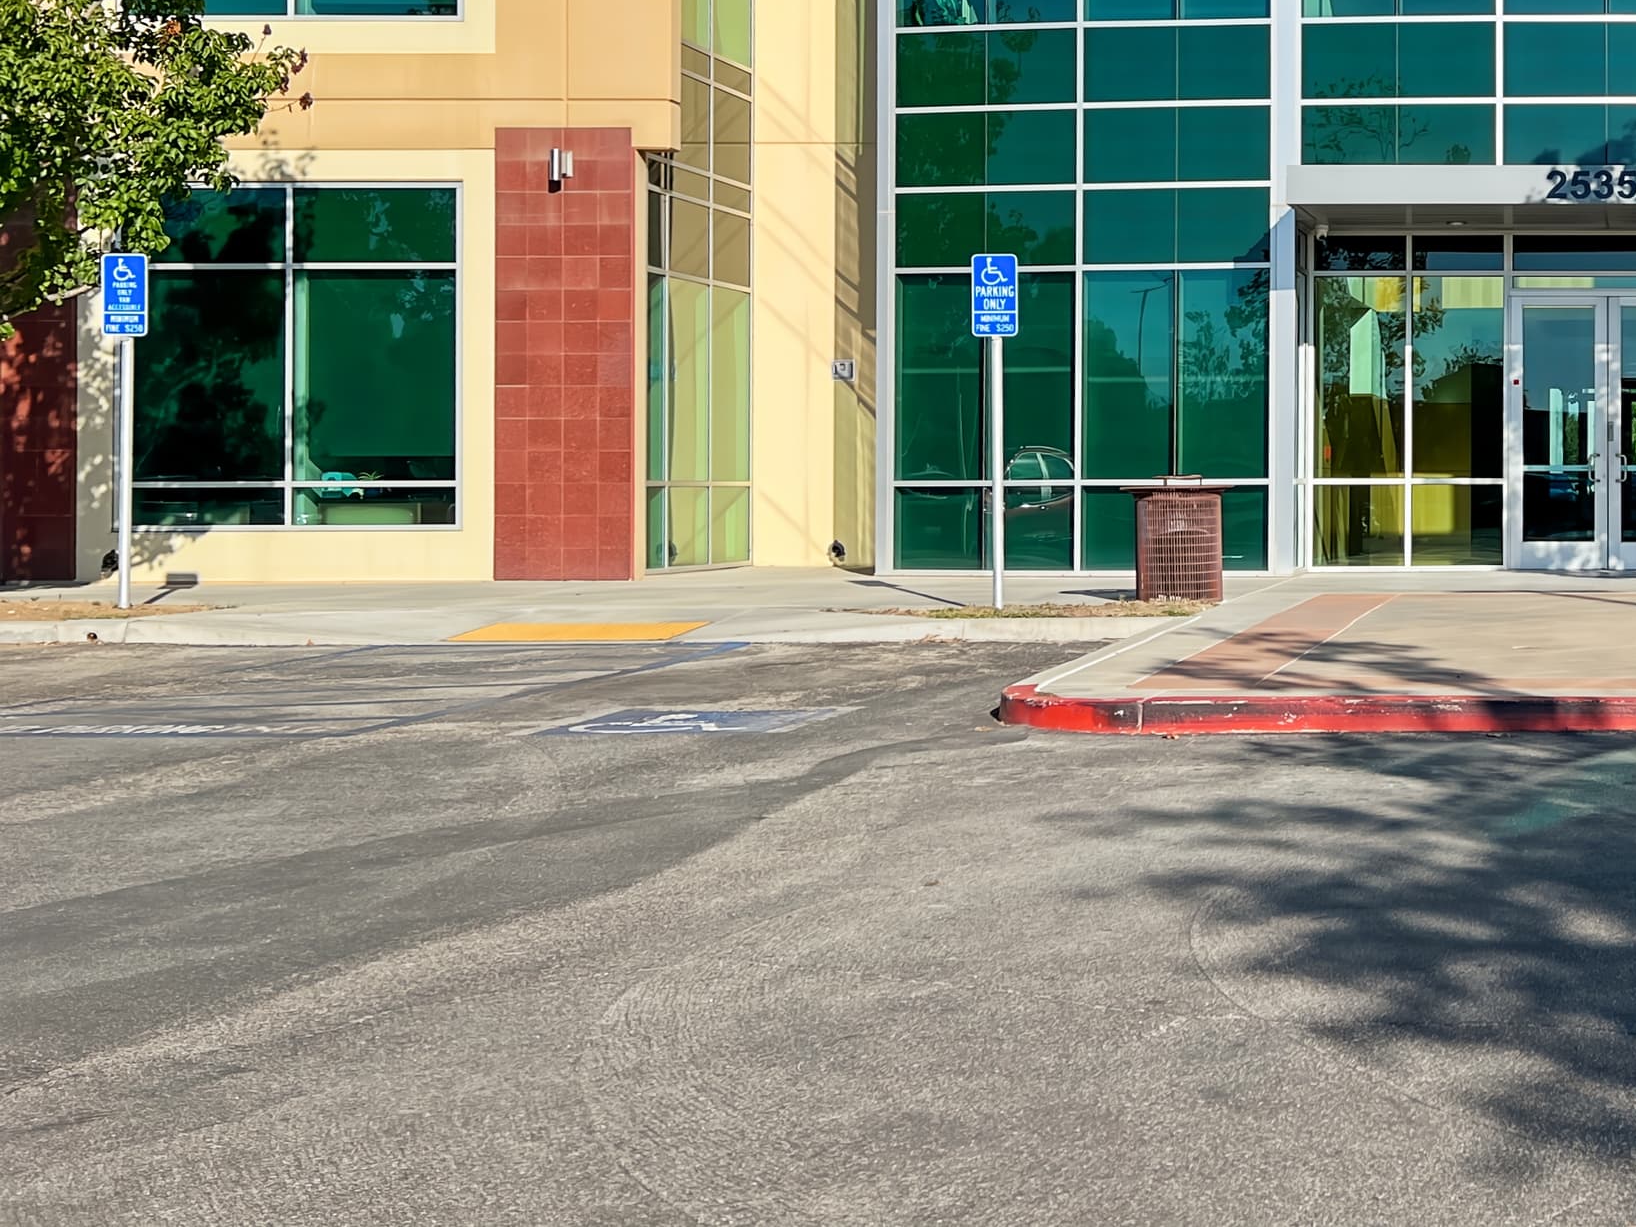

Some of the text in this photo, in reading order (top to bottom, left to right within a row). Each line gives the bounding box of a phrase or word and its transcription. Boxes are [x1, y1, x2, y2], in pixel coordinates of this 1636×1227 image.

[975, 285, 1015, 298] PARKING
[983, 298, 1006, 310] ONLY
[975, 324, 991, 332] FINE
